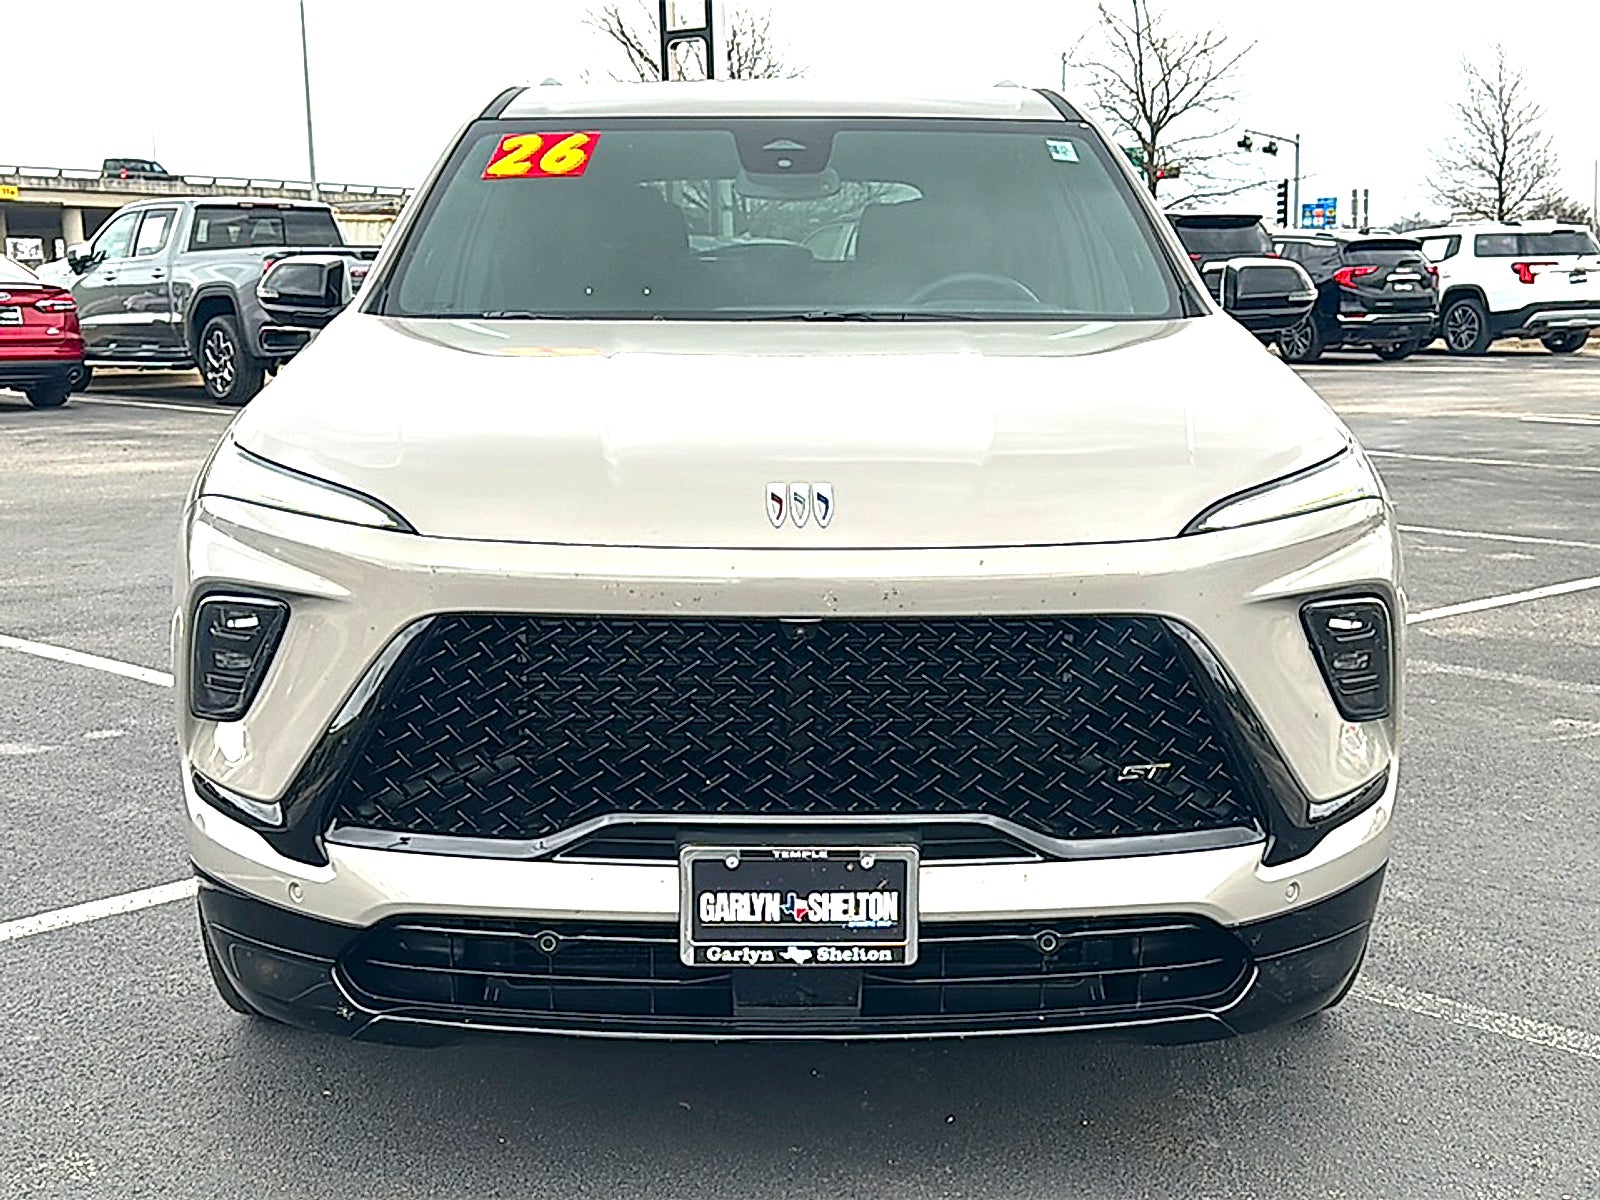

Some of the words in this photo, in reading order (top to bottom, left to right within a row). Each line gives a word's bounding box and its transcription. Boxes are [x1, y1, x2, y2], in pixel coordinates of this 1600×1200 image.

[486, 132, 591, 176] 26
[1117, 762, 1171, 781] ST
[772, 850, 828, 859] TEMPLE
[699, 892, 781, 922] GARLYN
[807, 892, 899, 922] SHELTON
[706, 946, 775, 964] Garlyn
[816, 946, 893, 962] Shelton
